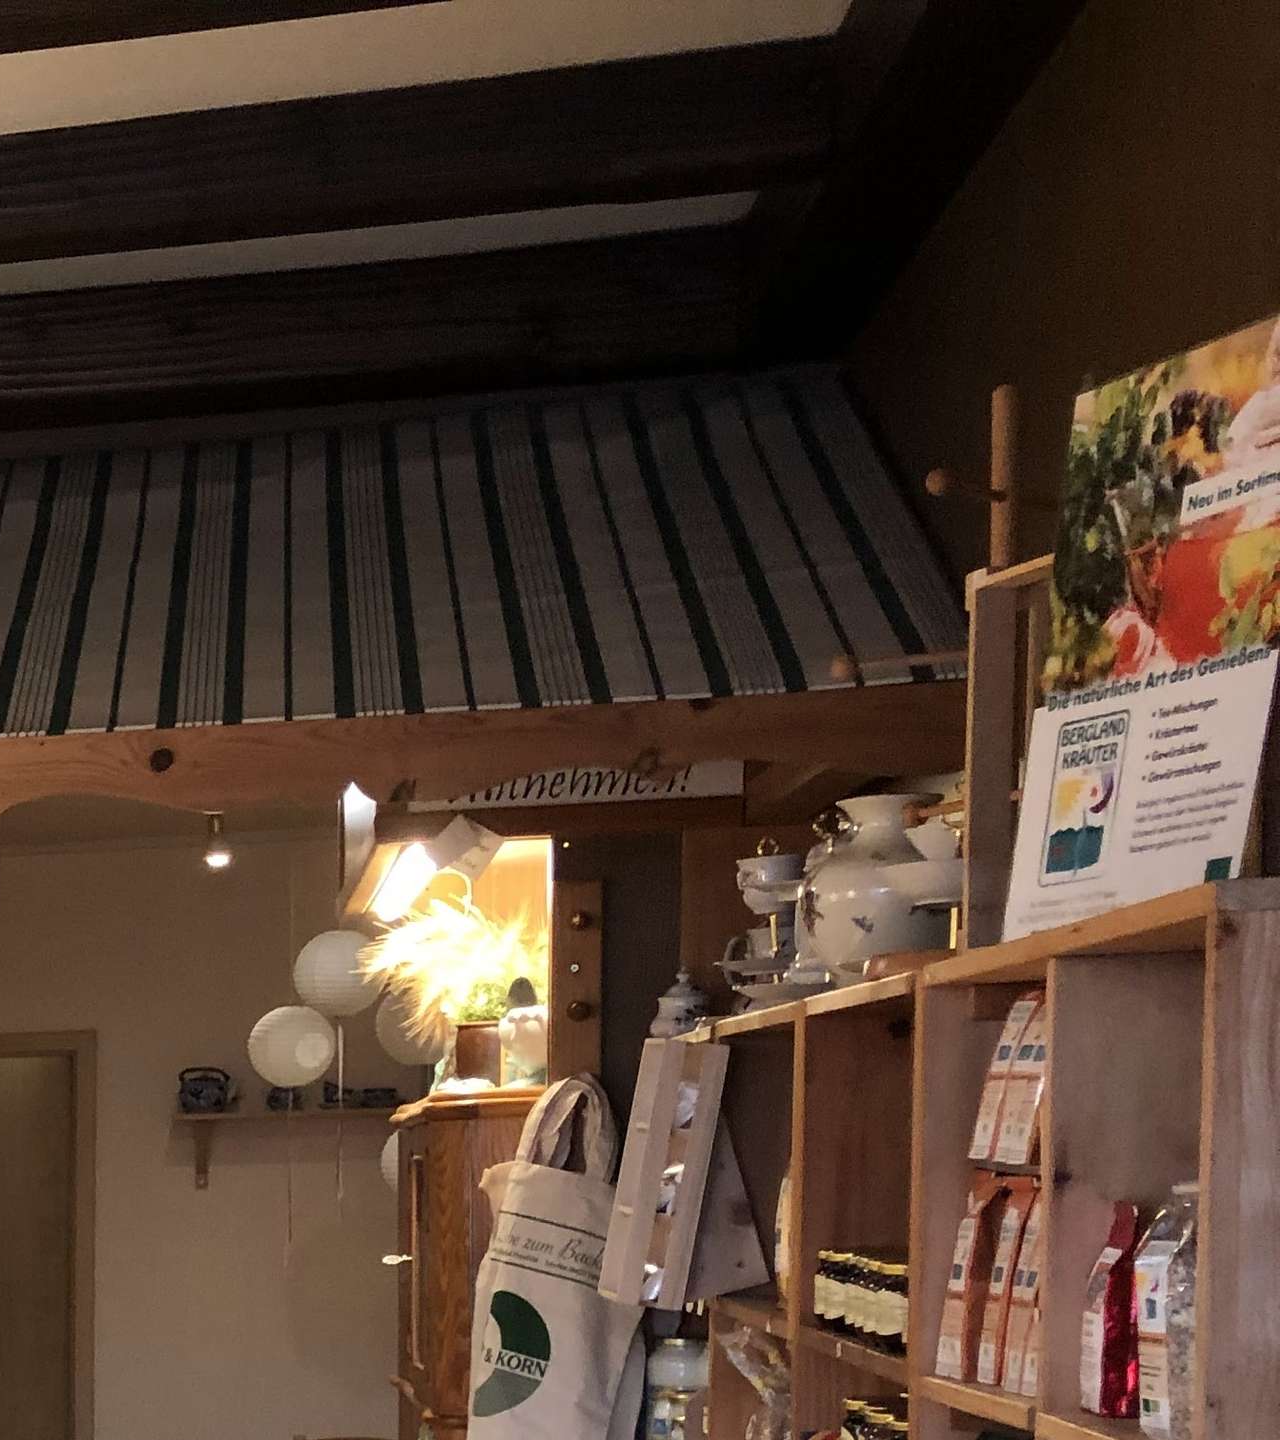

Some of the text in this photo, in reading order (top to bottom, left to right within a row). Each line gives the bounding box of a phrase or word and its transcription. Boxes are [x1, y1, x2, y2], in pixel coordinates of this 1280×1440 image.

[1072, 678, 1142, 706] natürliche
[1144, 670, 1167, 690] Art
[1170, 664, 1194, 684] des
[1197, 646, 1272, 677] Genießens
[1061, 718, 1126, 747] BERGLAND
[1062, 742, 1119, 769] KRÄUTER
[495, 1350, 549, 1378] KORN
